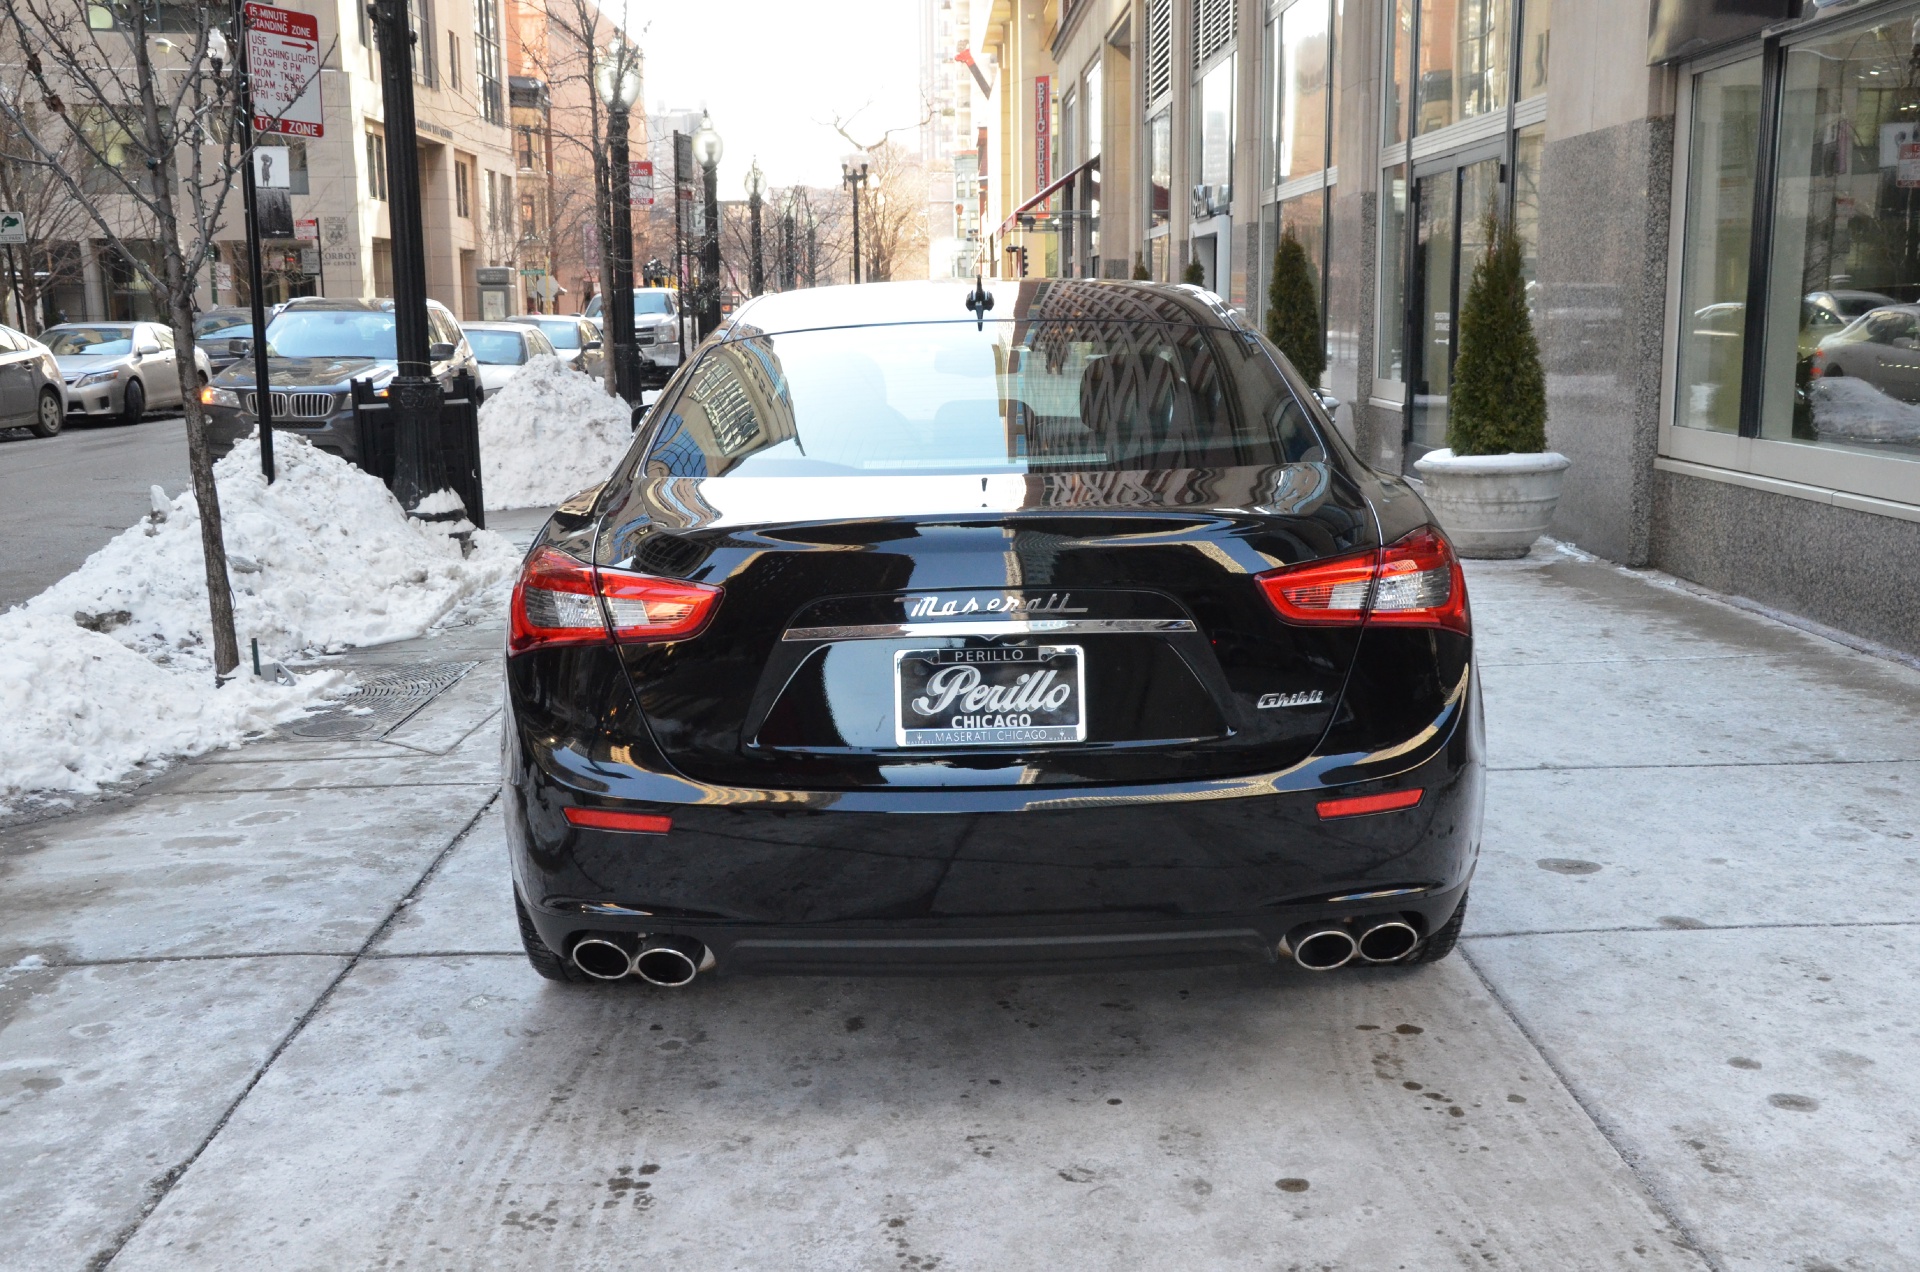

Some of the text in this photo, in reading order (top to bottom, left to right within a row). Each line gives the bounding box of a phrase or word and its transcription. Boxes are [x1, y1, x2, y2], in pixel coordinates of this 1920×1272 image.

[249, 6, 288, 22] 15 MINUTE
[250, 18, 311, 37] STANDING ZONE
[252, 35, 267, 46] USE
[252, 46, 316, 65] FLASHING LIGHTS
[253, 57, 262, 66] 10
[264, 58, 275, 68] AM
[283, 61, 288, 70] 8
[291, 63, 301, 72] PM
[254, 68, 271, 78] MON
[280, 71, 306, 84] THURS
[254, 78, 262, 88] 10
[264, 80, 276, 89] AM
[284, 83, 289, 92] 6
[291, 84, 302, 93] PM
[255, 90, 268, 99] FRI
[257, 117, 319, 136] TO ZONE
[894, 593, 1089, 617] Maserati
[955, 650, 1024, 662] PERILLO
[911, 665, 1071, 716] Perillo
[1256, 690, 1323, 709] Ghibli
[951, 714, 1032, 729] CHICAGO
[935, 729, 1047, 742] MASERATI CHICAGO
